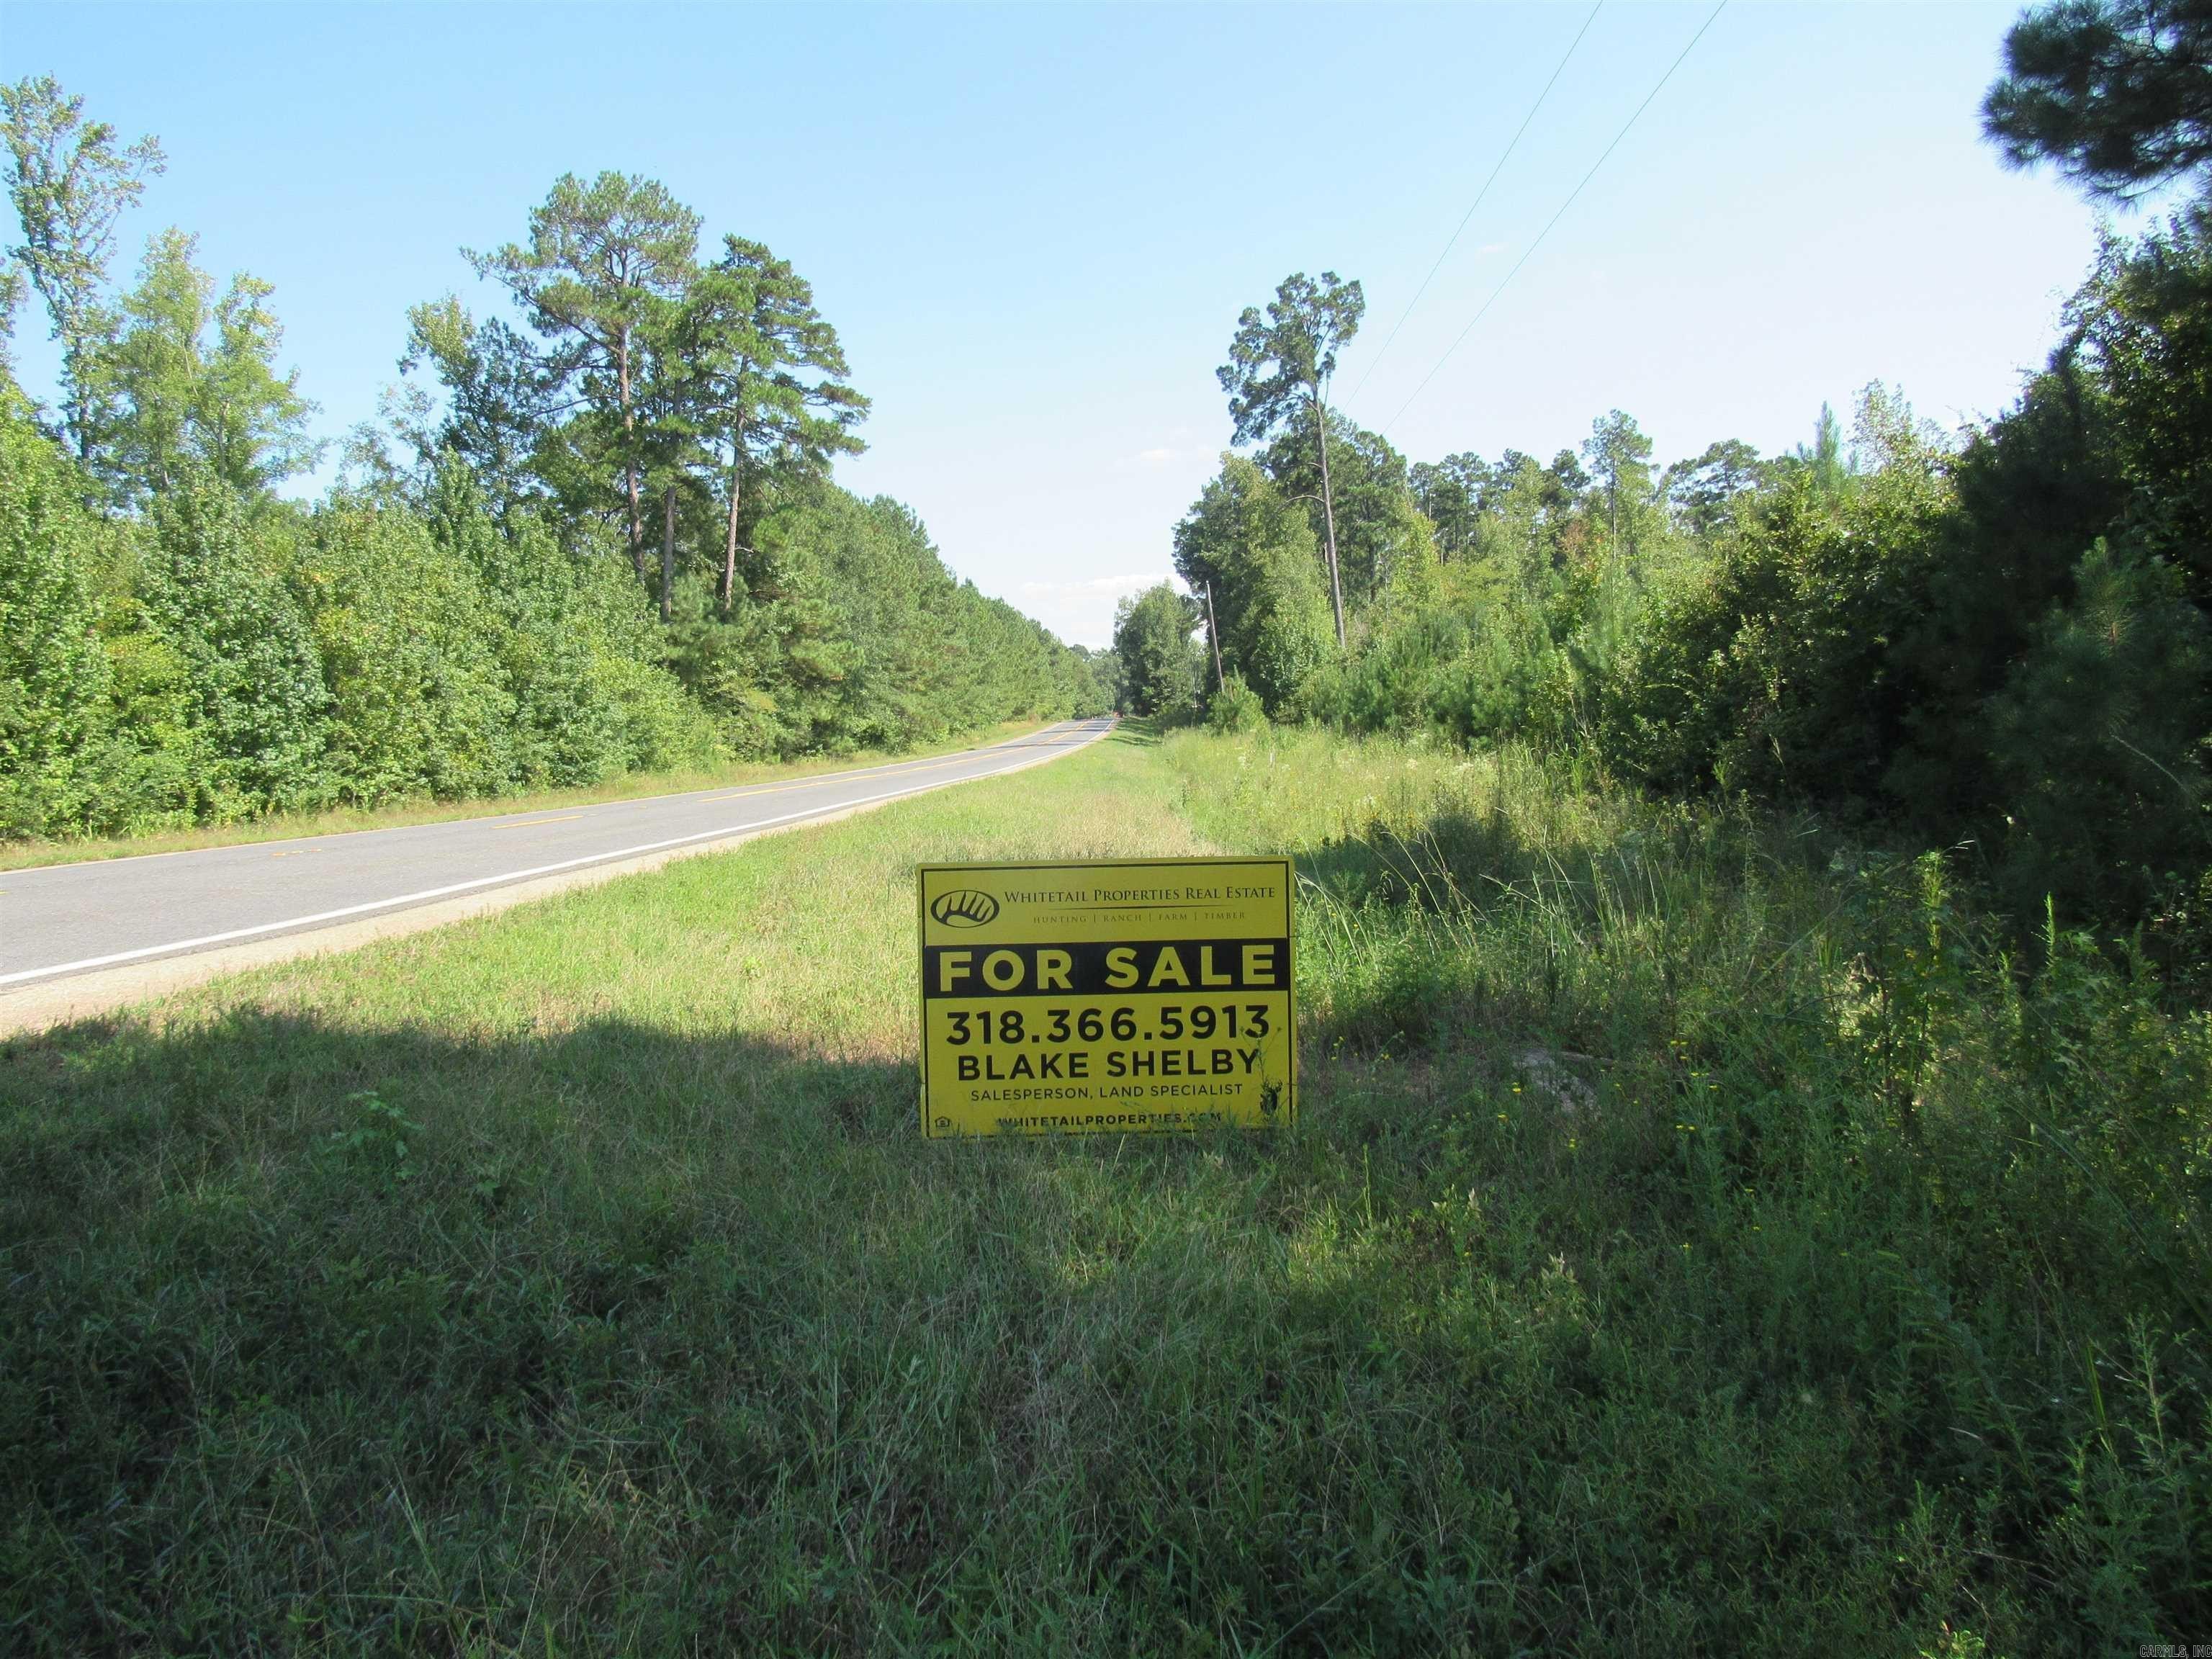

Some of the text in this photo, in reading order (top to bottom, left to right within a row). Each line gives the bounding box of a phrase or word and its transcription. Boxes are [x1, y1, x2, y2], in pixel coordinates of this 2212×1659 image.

[1004, 886, 1275, 903] WHITETAIL PROPERTIES REAL ESTATE
[1033, 915, 1087, 924] HUNTING
[1104, 914, 1142, 922] RANCH
[1205, 912, 1245, 920] TIMBER
[939, 945, 1276, 992] FOR SALE
[946, 1004, 1269, 1046] 318.366.5913
[958, 1048, 1259, 1081] BLAKE SHELBY
[971, 1083, 1243, 1101] SALESPERSON, LAND SPECIALIST
